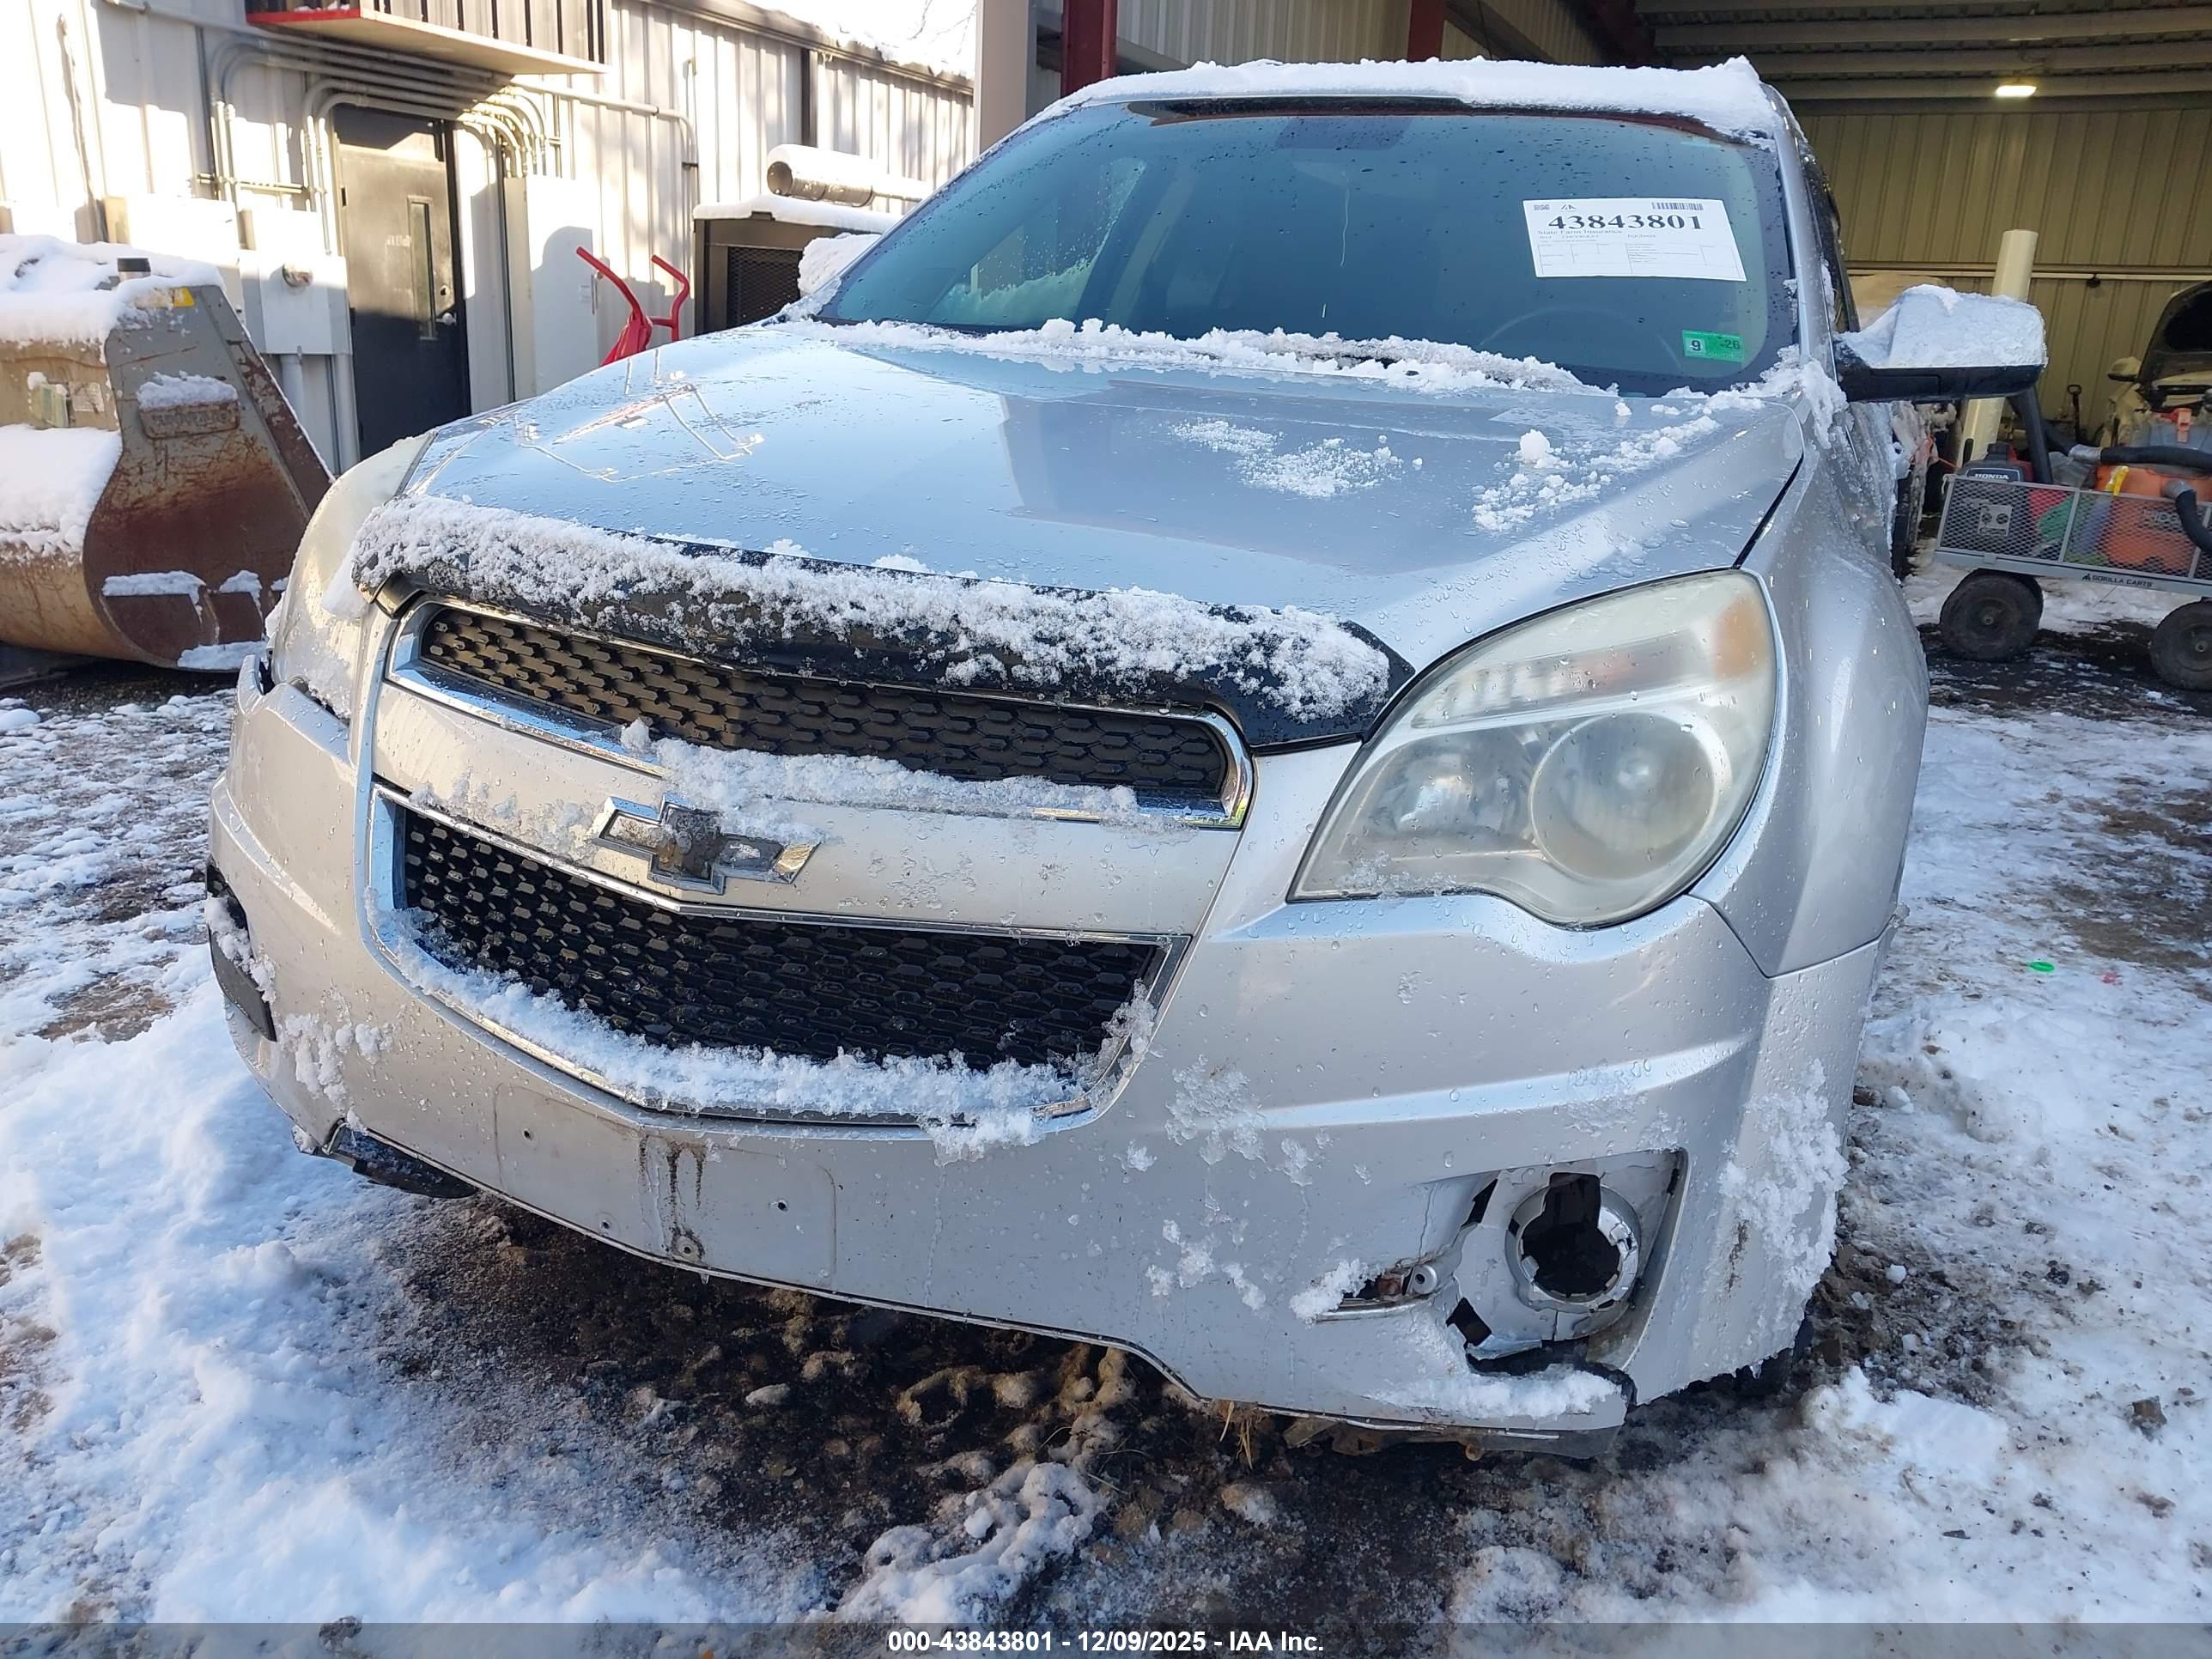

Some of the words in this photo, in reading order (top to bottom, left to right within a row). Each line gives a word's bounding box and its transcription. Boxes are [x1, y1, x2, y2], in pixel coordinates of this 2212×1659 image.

[1548, 214, 1705, 230] 43843801
[1692, 339, 1701, 351] 9
[2092, 574, 2124, 584] GORILLA
[2126, 579, 2153, 587] CARTS
